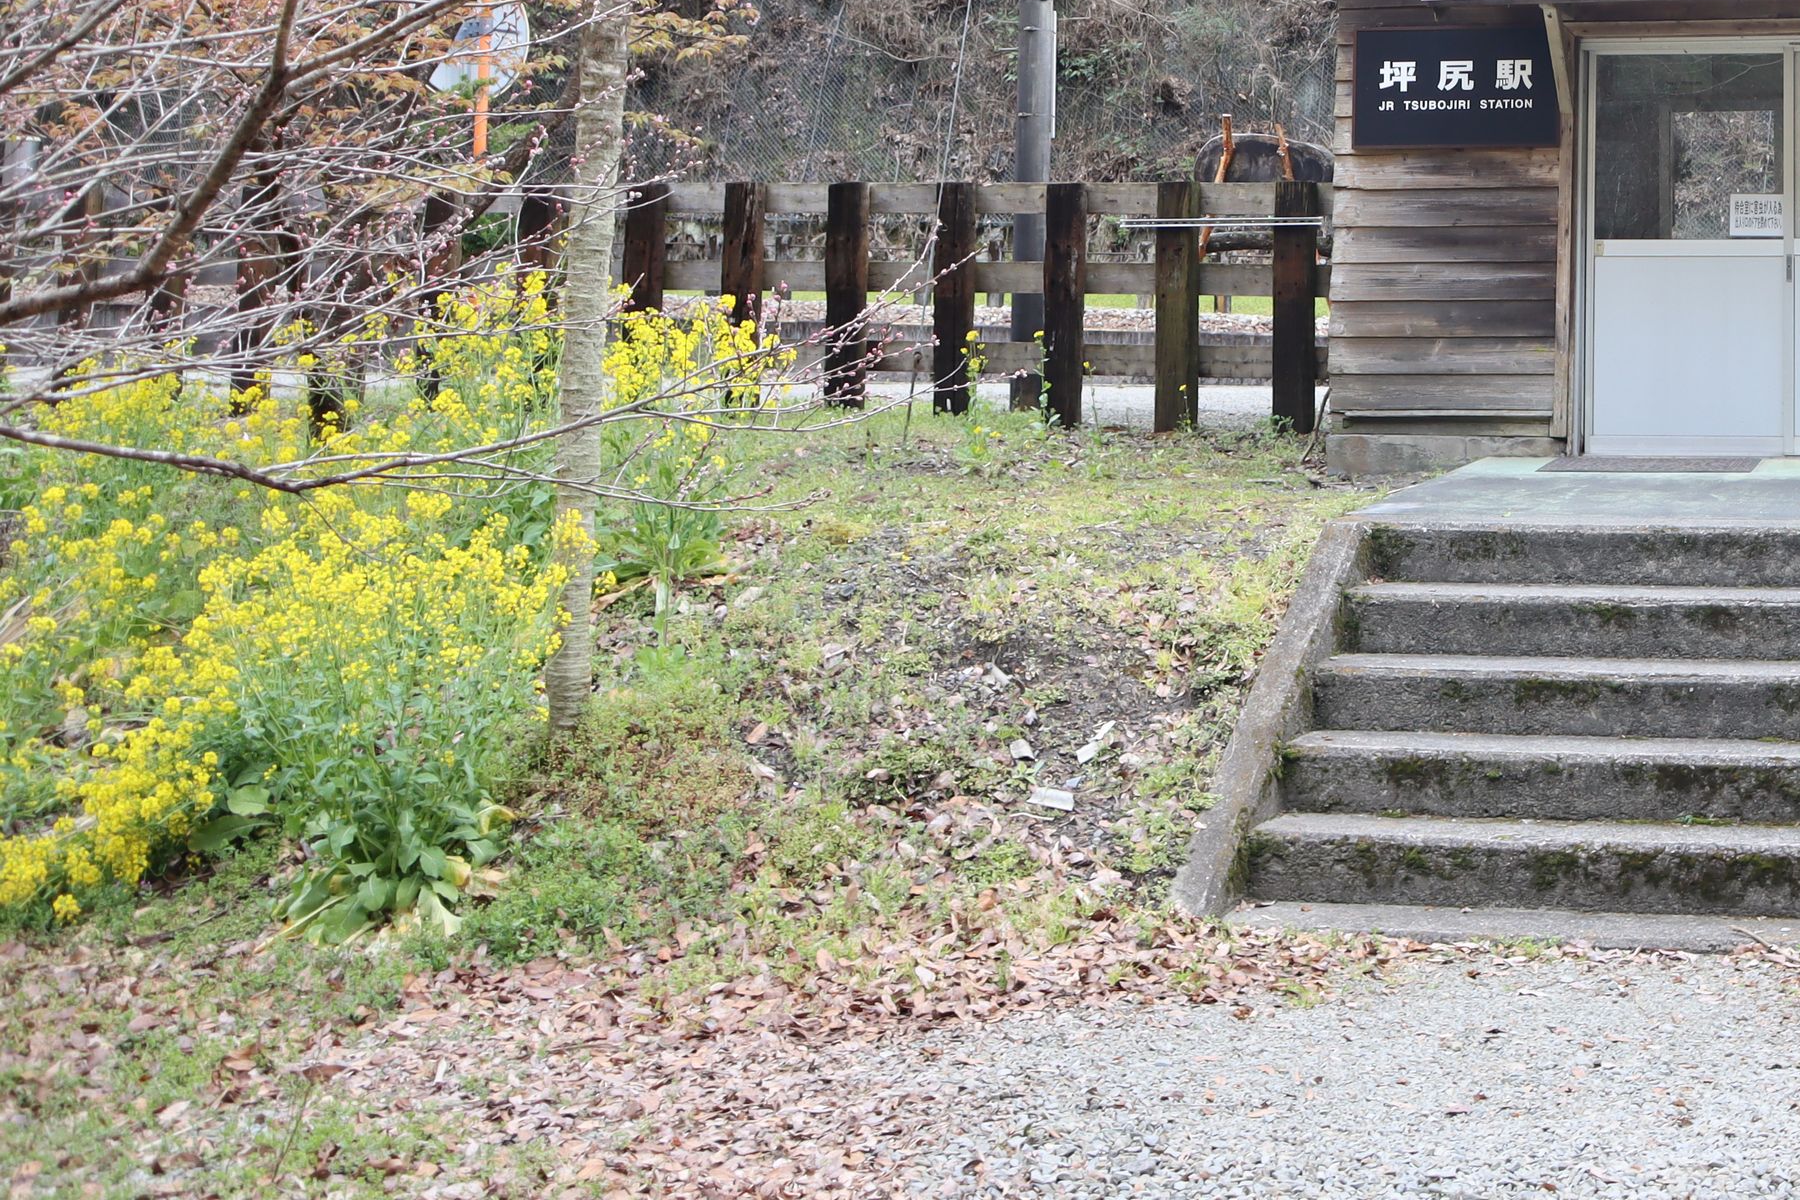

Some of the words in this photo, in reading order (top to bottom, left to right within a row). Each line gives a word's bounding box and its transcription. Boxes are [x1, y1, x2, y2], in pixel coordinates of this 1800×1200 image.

[1378, 59, 1533, 93] 坪尻駅
[1378, 101, 1395, 111] JR
[1403, 100, 1471, 111] TSUBOJIRI
[1479, 99, 1533, 110] STATION
